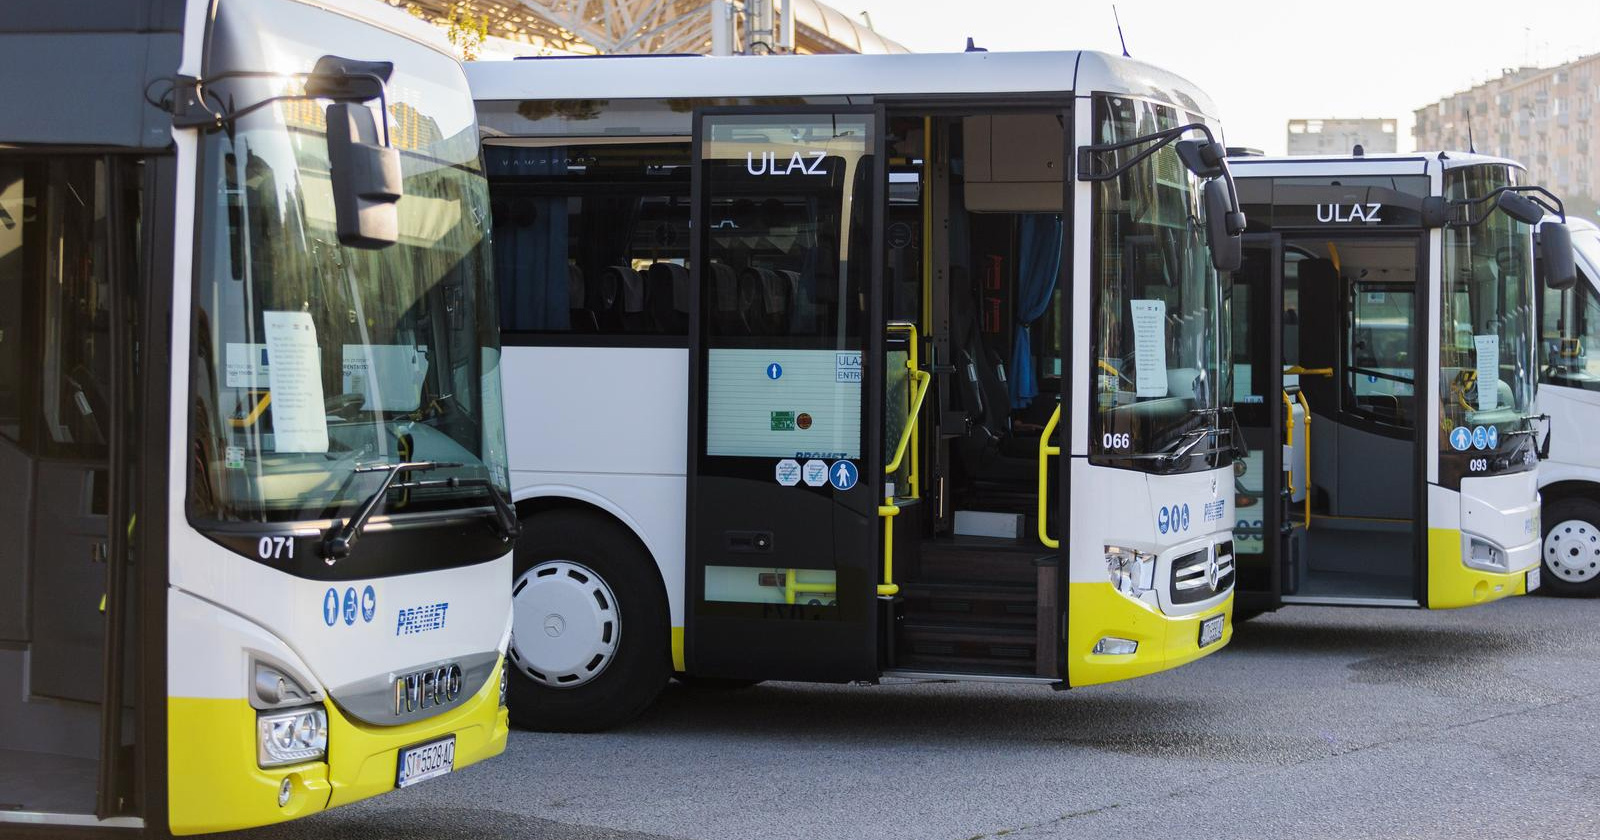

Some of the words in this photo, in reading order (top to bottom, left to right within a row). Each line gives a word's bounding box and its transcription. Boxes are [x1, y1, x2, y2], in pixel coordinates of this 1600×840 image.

[747, 151, 827, 176] ULAZ
[1317, 203, 1381, 223] ULAZ
[839, 355, 862, 366] ULA
[837, 371, 862, 380] ENTR
[1102, 433, 1130, 449] 066
[1469, 458, 1488, 472] 093
[258, 536, 295, 560] 071
[396, 602, 449, 636] PROMET
[395, 664, 462, 716] IVECO
[405, 752, 417, 778] ST
